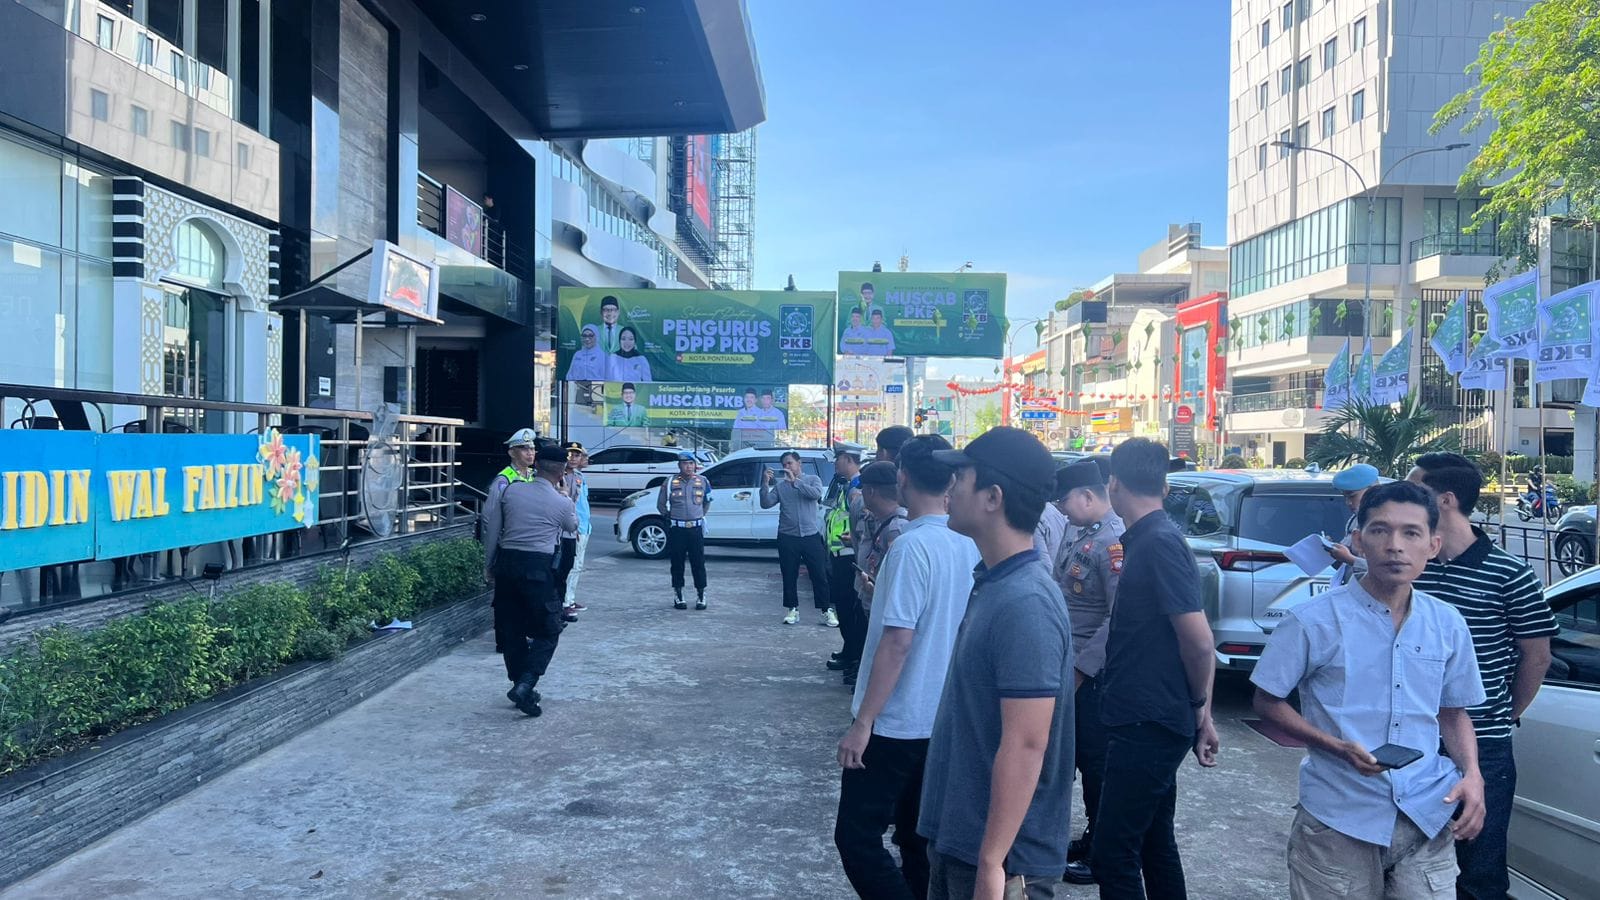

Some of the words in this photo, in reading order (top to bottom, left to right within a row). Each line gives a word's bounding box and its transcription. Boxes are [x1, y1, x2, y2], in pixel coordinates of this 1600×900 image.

[885, 291, 957, 305] MUSCAB
[663, 319, 771, 336] PENGURUS
[675, 335, 716, 351] DPP
[719, 336, 759, 353] PKB
[780, 338, 812, 348] PKB
[658, 385, 685, 393] Selamat
[686, 386, 711, 394] Datang
[650, 394, 712, 407] MUSCAB
[715, 395, 744, 408] PKB
[0, 469, 91, 529] IDIN
[106, 468, 169, 521] WAL
[182, 464, 263, 512] FAIZIN
